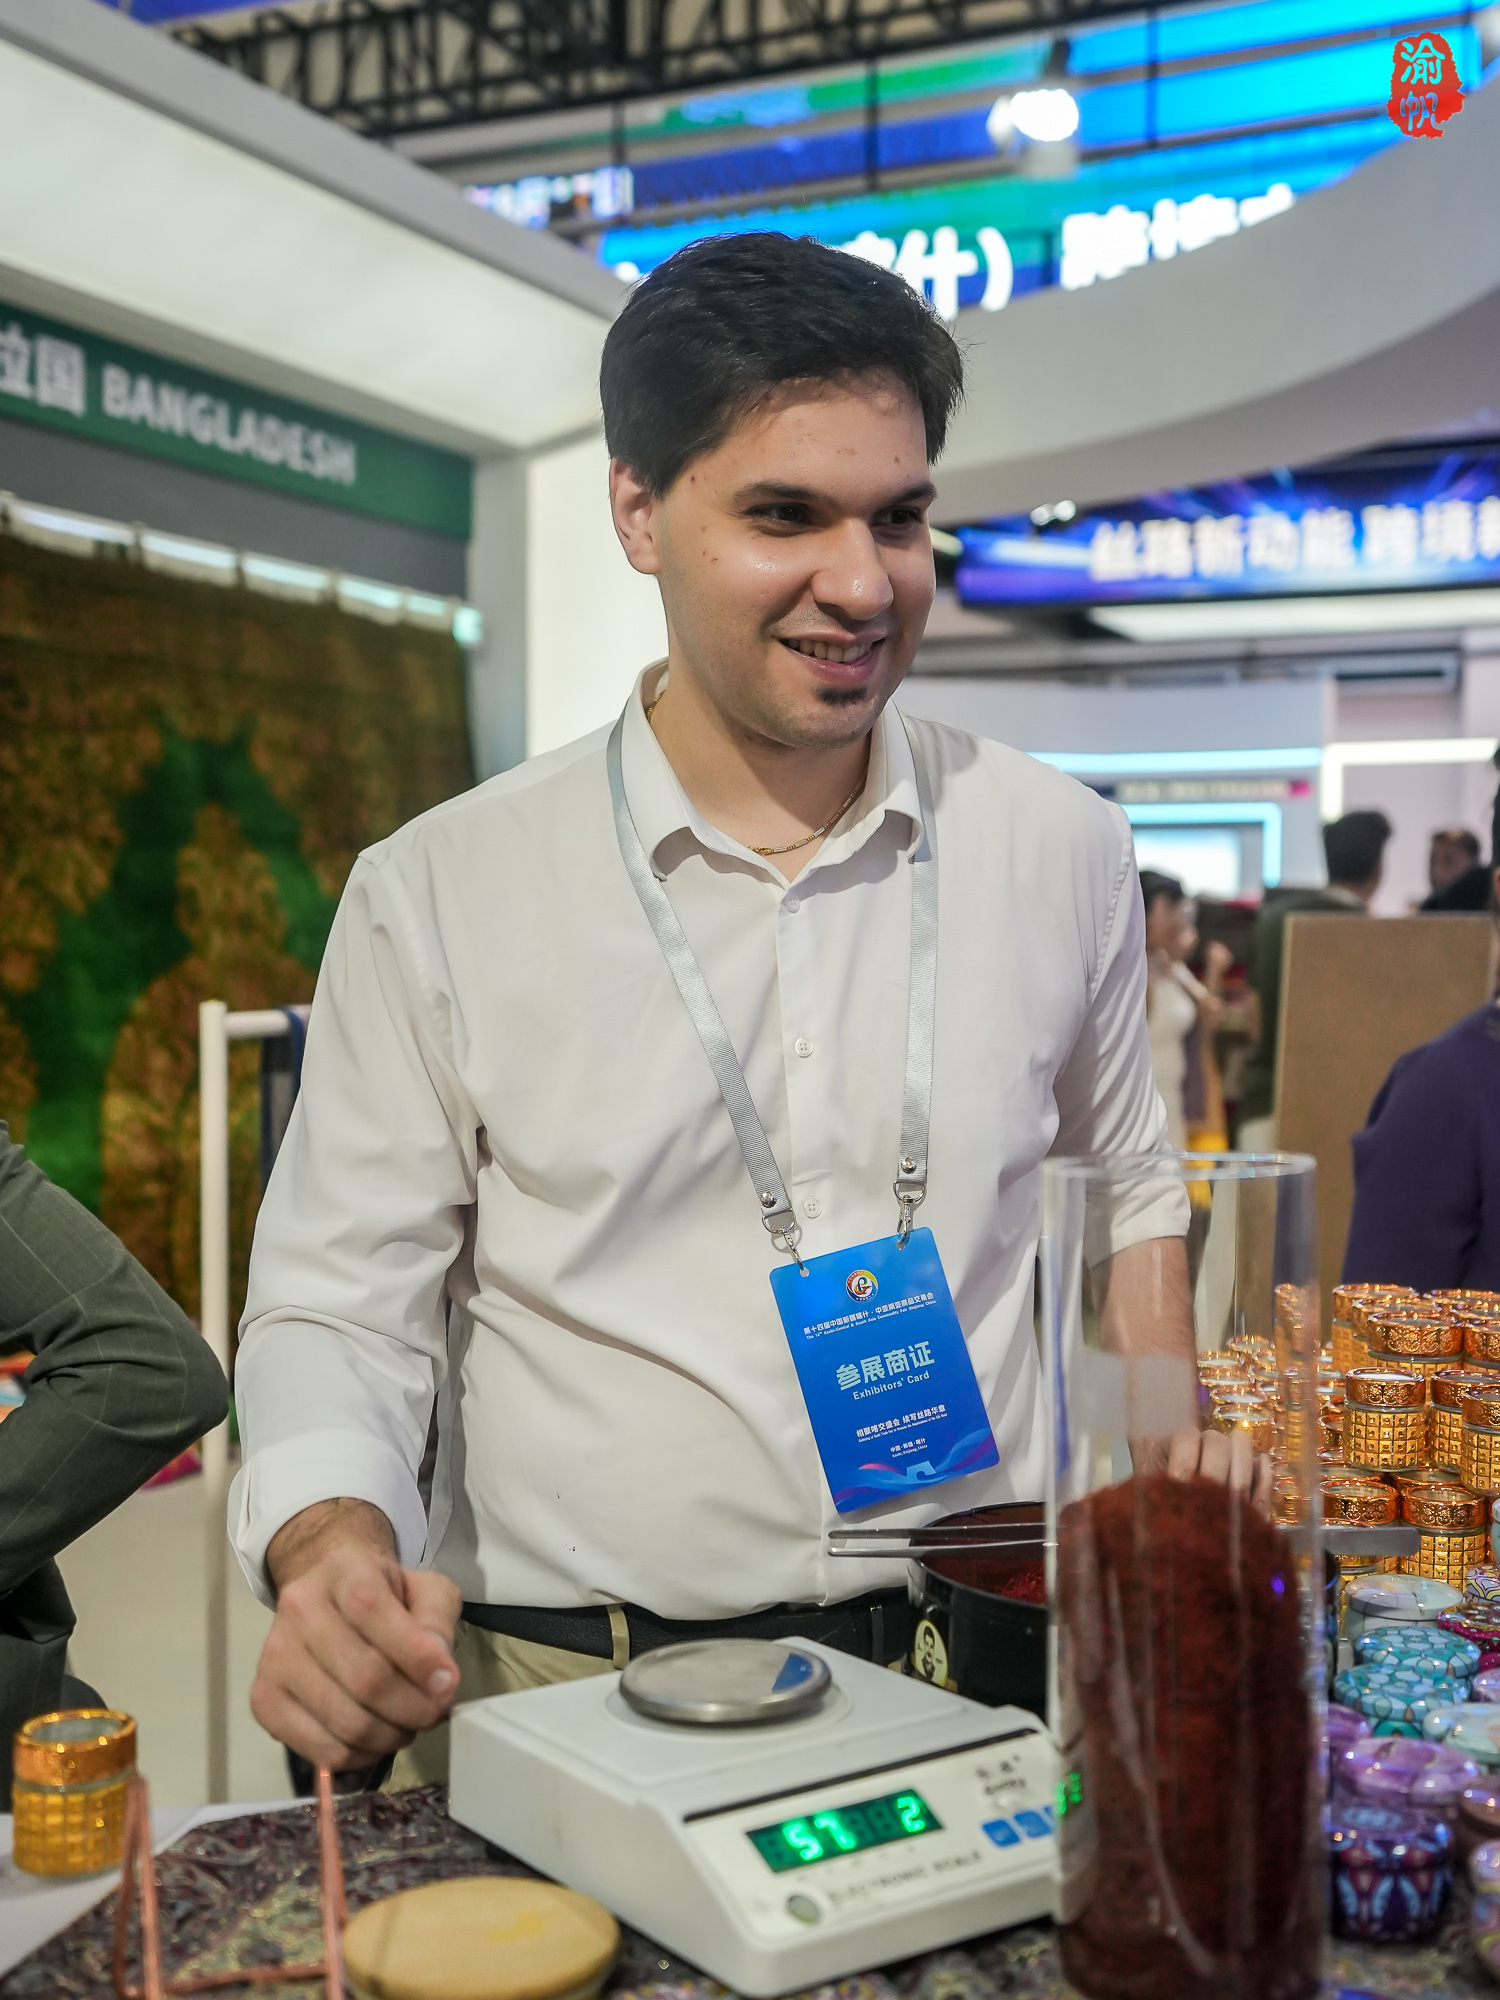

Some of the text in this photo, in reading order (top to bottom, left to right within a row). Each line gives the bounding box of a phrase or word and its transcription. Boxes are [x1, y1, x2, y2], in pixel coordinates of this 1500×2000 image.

[103, 364, 355, 484] BANGLADESH
[836, 1340, 935, 1390] 参展商证
[907, 1370, 929, 1383] Card
